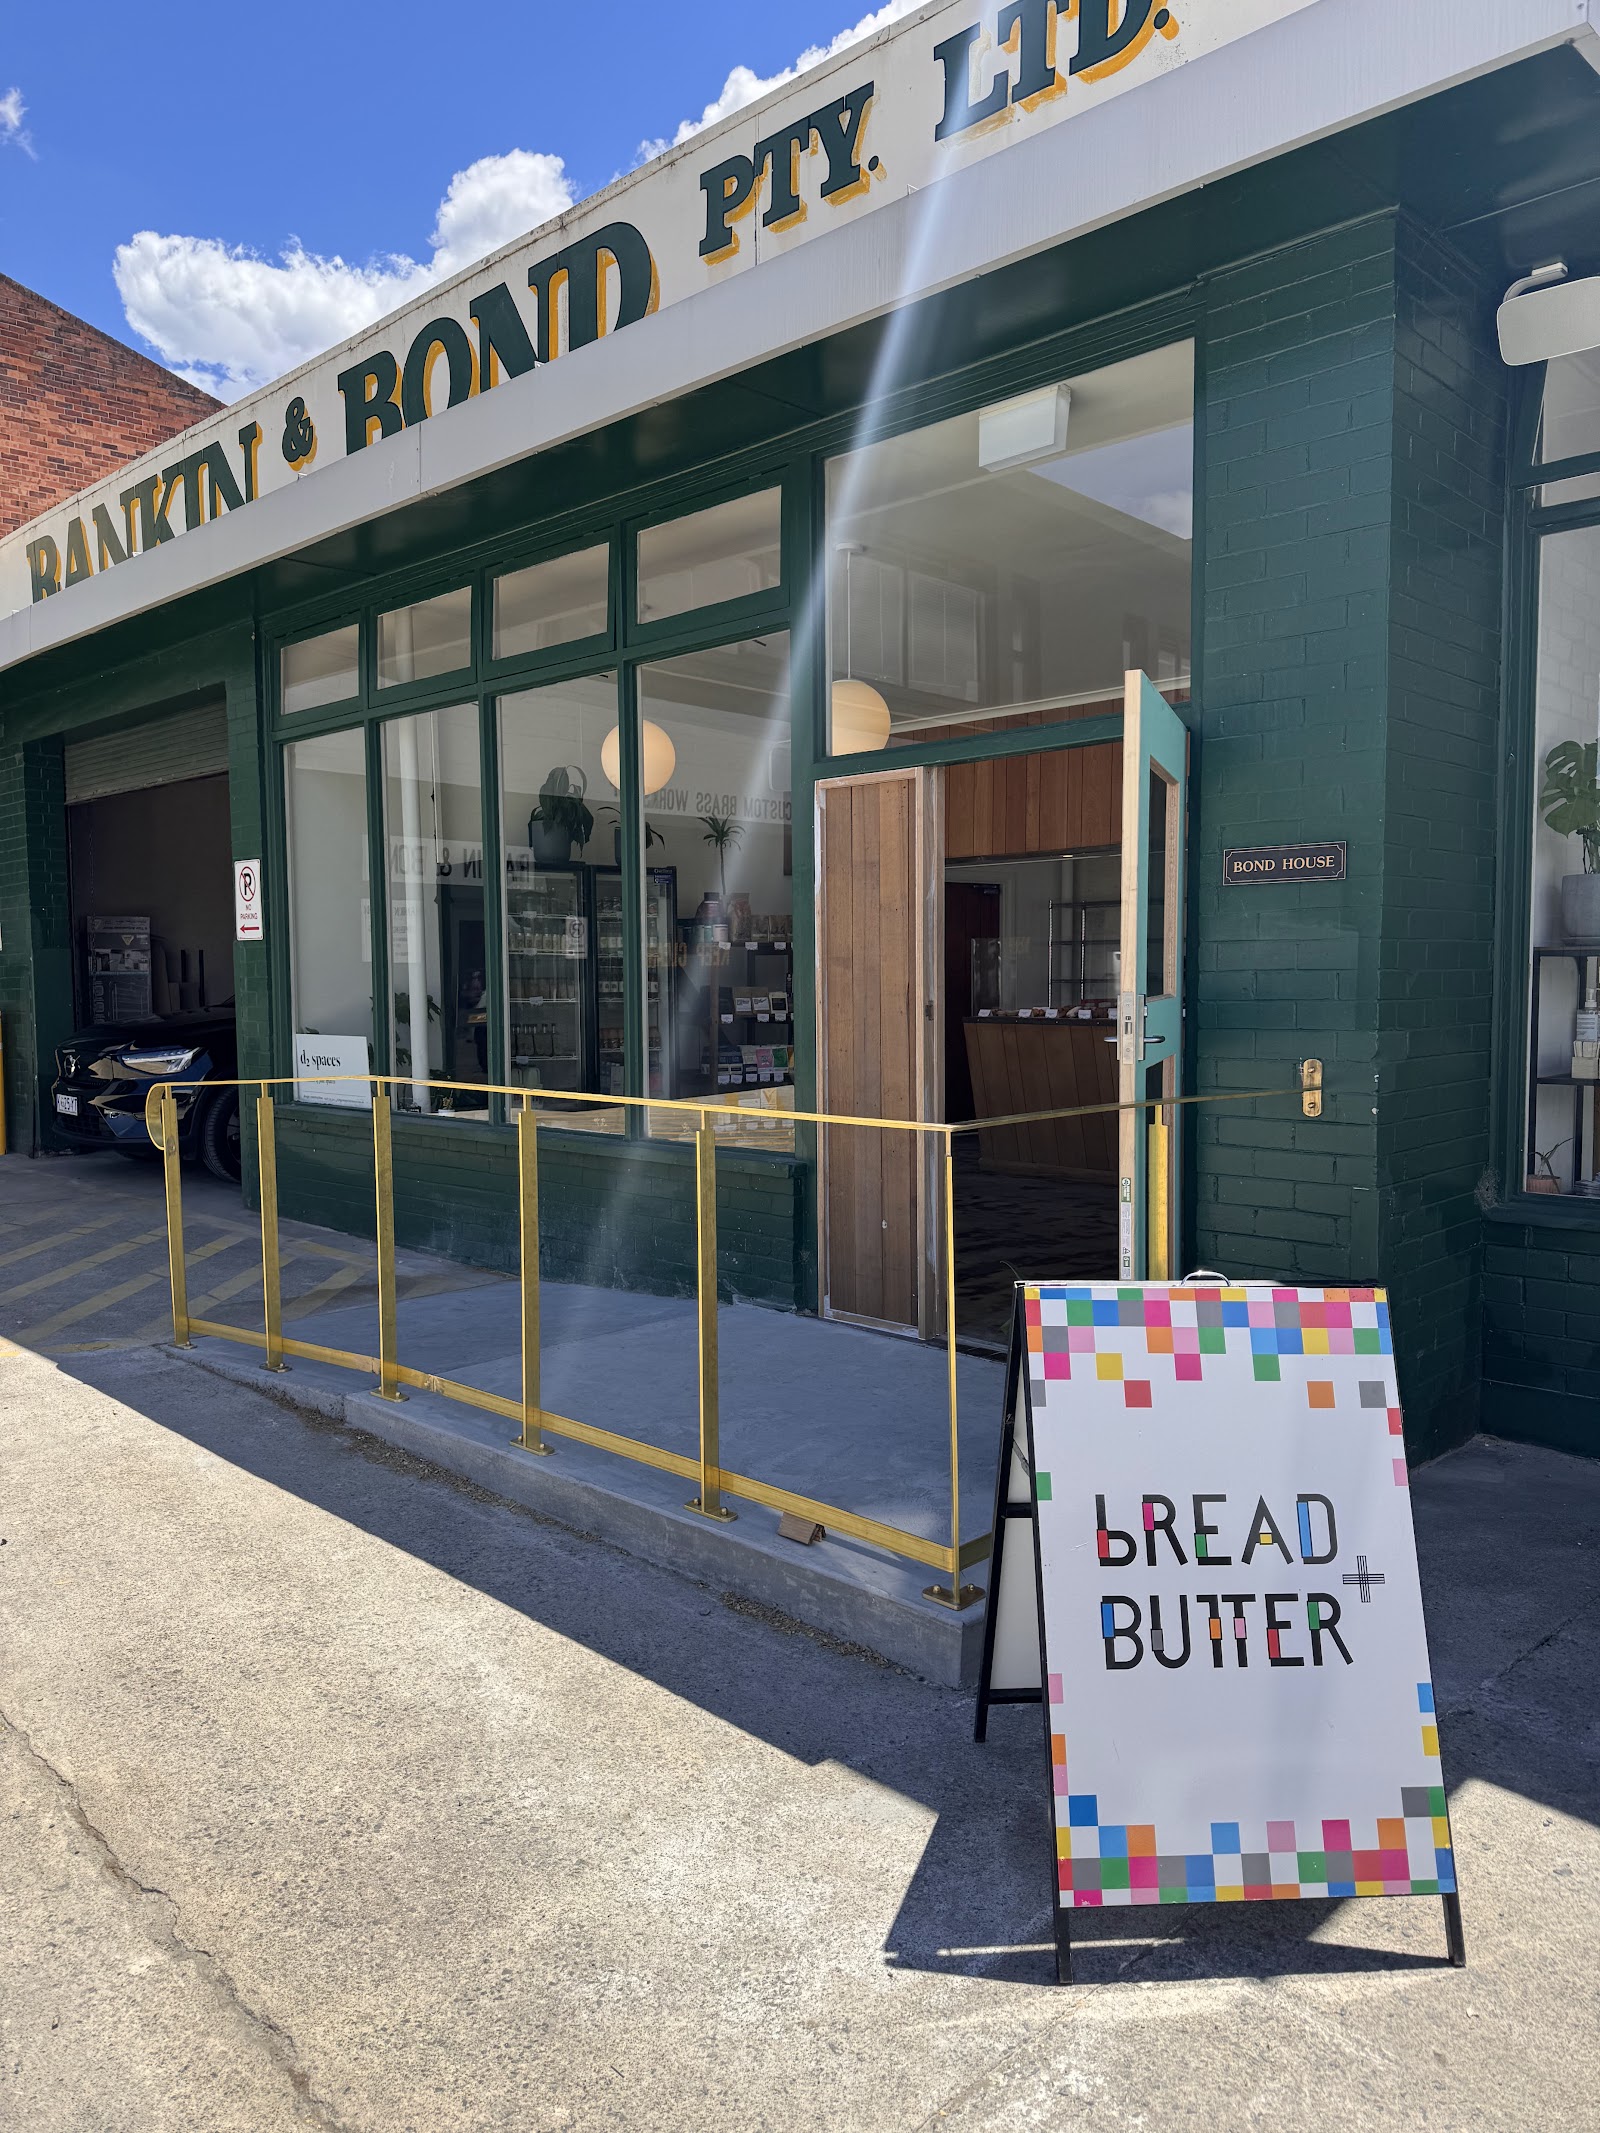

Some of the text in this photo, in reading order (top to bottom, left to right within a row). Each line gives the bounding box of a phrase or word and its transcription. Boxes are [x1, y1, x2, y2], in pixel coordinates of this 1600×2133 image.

[26, 0, 1177, 604] RANKIN & BOND PTY. LTD.
[1233, 855, 1335, 873] BOND HOUSE
[311, 1055, 341, 1071] spaces
[1100, 1592, 1354, 1670] BUTTER
